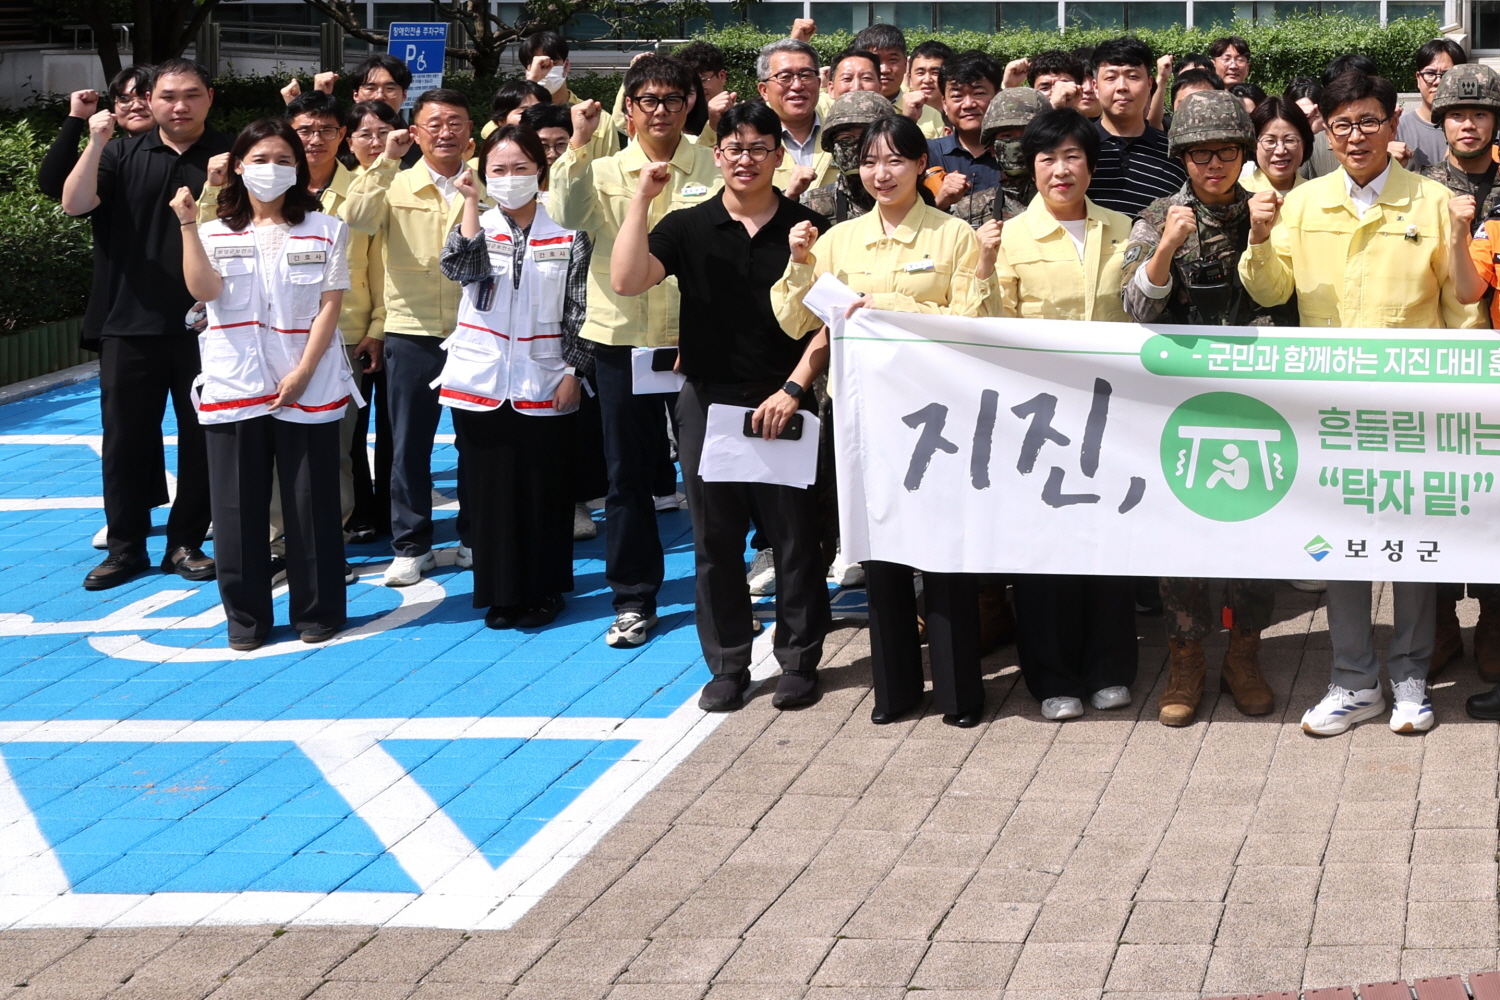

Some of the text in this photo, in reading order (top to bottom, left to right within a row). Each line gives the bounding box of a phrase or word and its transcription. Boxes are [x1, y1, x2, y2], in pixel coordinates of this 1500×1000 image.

[405, 44, 417, 67] P
[293, 254, 322, 262] 간호사
[1207, 343, 1280, 373] 군민과
[1284, 345, 1379, 375] 함께하는
[1383, 347, 1430, 376] 지진
[1436, 348, 1482, 377] 대비
[901, 377, 1146, 514] 지진,
[1318, 406, 1426, 454] 흔들릴
[1318, 466, 1495, 517] “탁자 밑!”
[1345, 539, 1441, 563] 보성군
